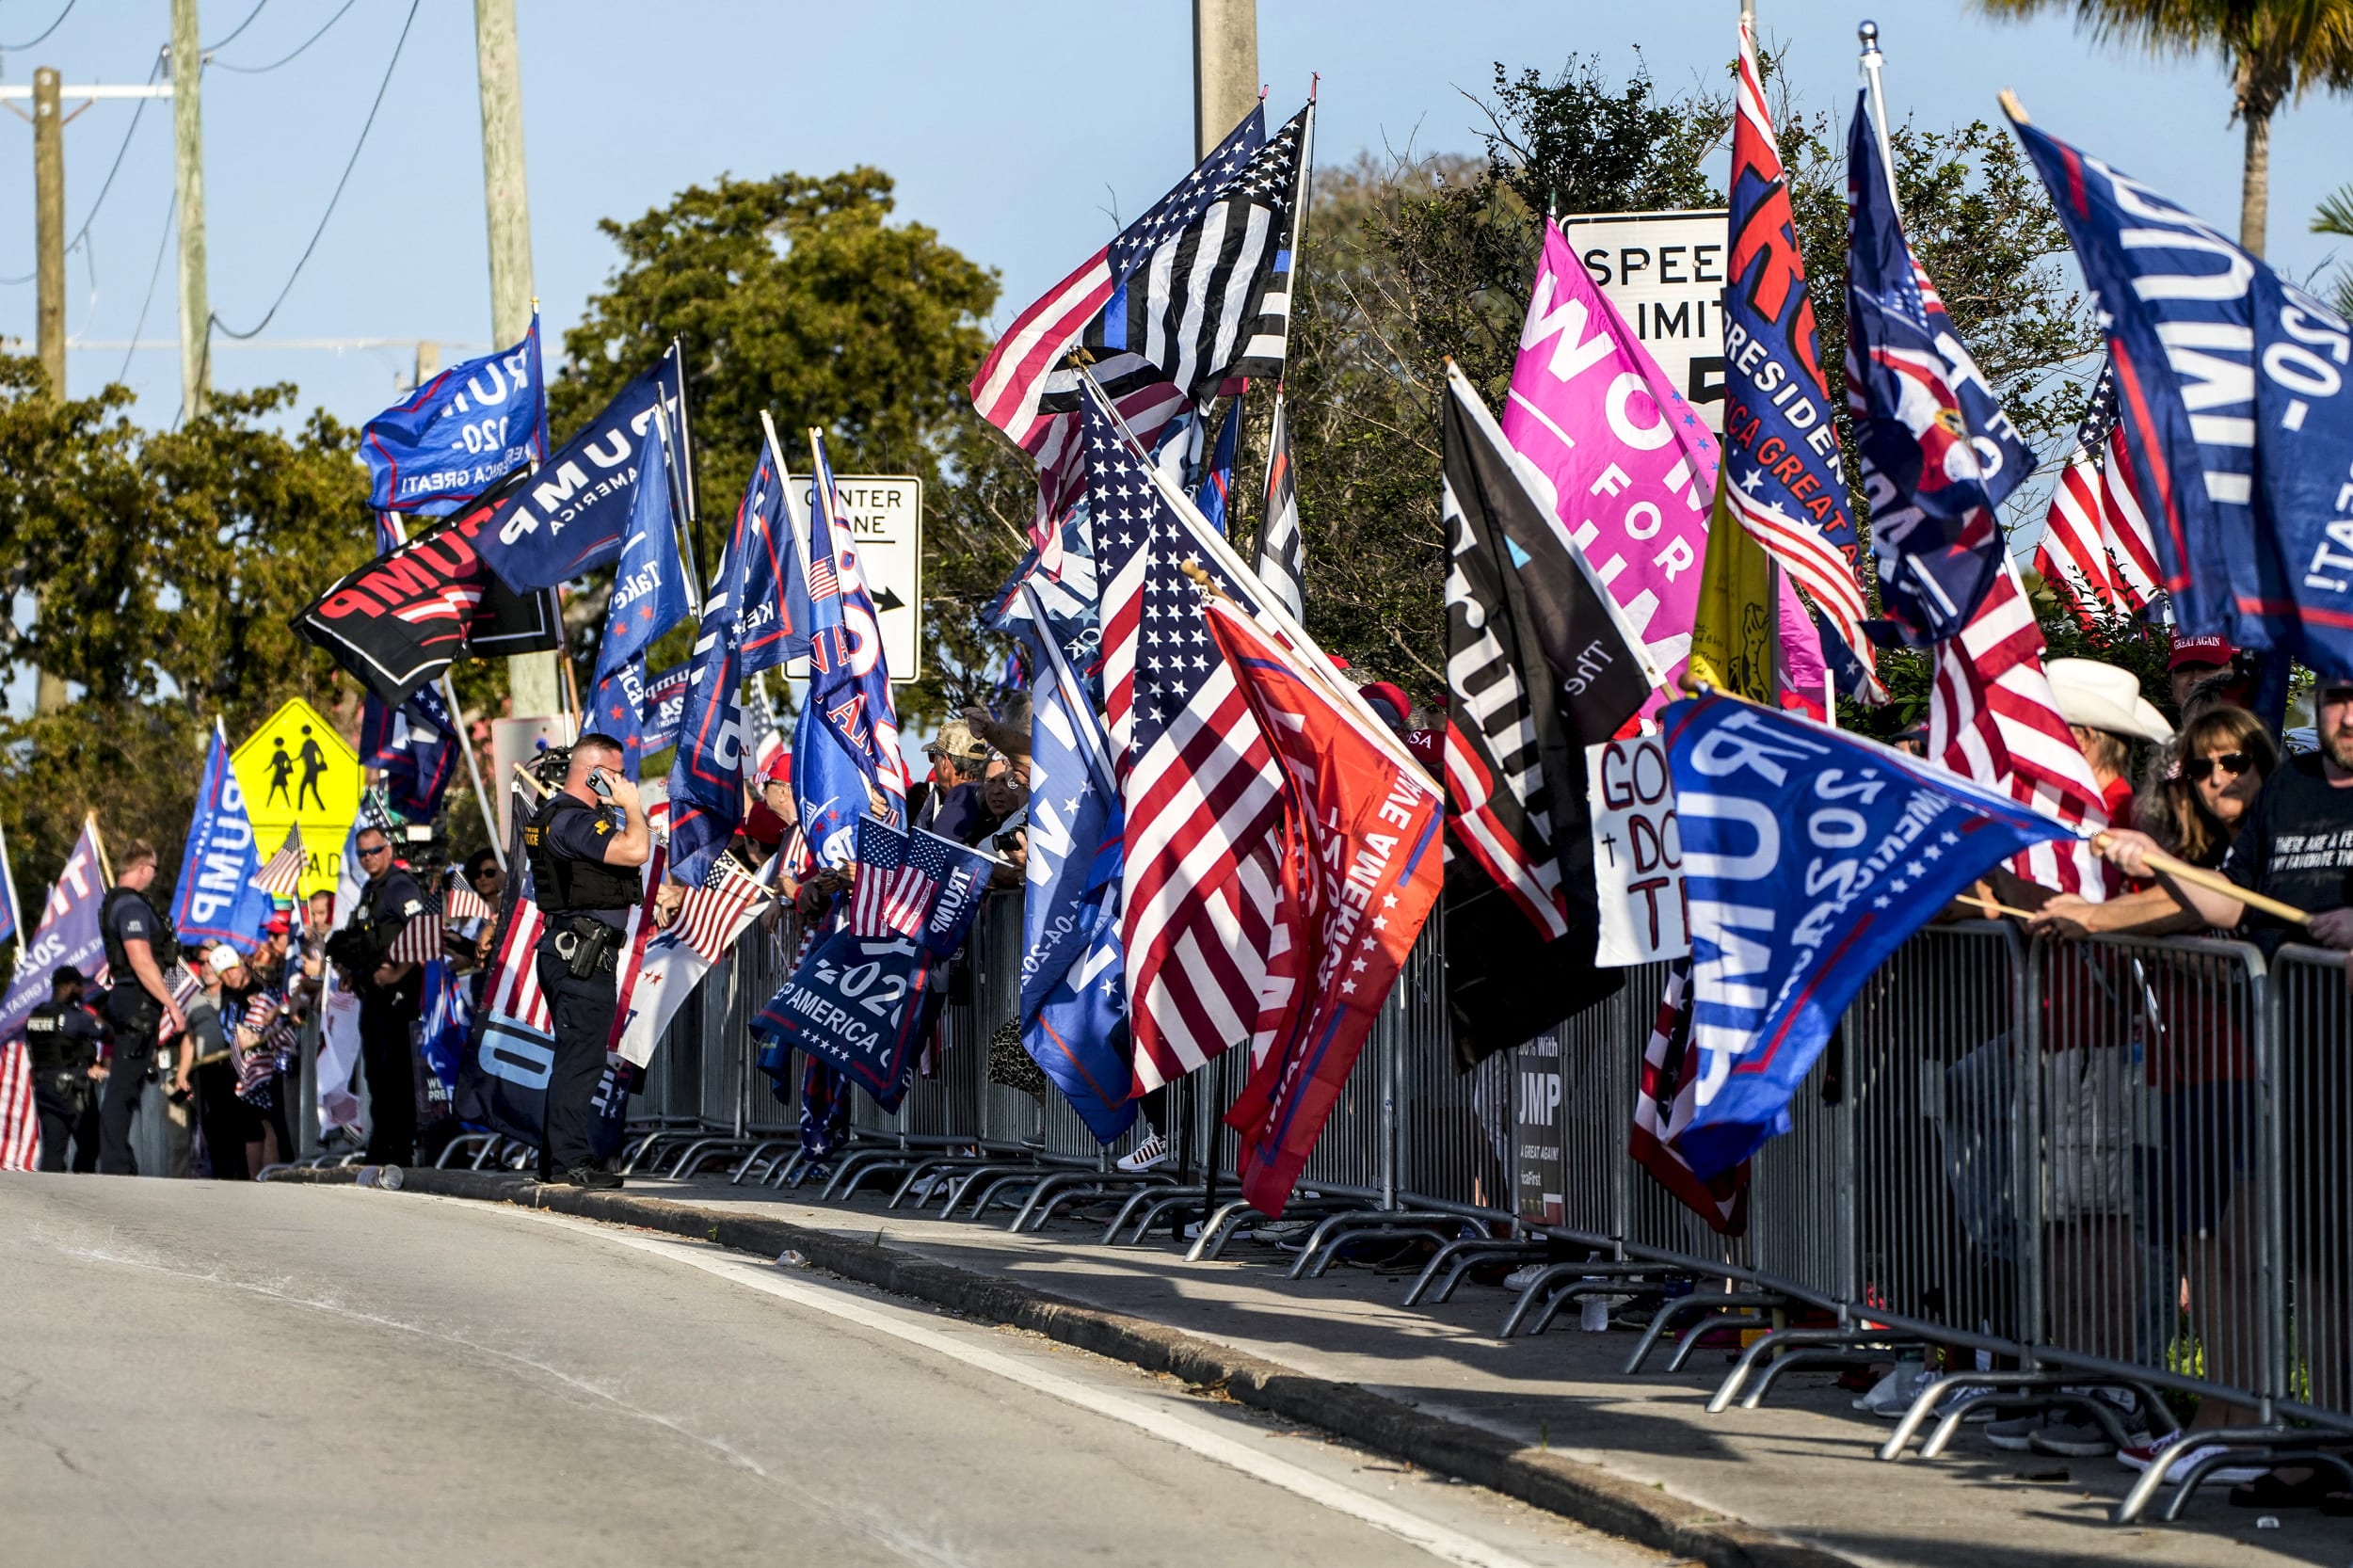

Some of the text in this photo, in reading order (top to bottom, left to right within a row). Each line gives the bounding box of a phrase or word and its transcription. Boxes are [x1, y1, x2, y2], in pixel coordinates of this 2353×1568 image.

[1584, 245, 1722, 286] SPEE
[1639, 300, 1724, 340] IMI
[1520, 269, 1713, 532] WOM
[1723, 312, 1851, 506] RESIDEN
[1757, 437, 1847, 533] GREAT
[805, 489, 901, 508] CNTER
[855, 516, 886, 534] NE
[1590, 461, 1694, 584] FOR
[2174, 636, 2220, 650] GREAT AGAIN
[1408, 730, 1432, 749] SA
[1601, 742, 1673, 811] GO
[2305, 834, 2329, 852] ARE
[2328, 832, 2338, 849] A
[2339, 830, 2353, 849] FE
[2286, 850, 2335, 870] FAVORITE
[787, 987, 878, 1053] AMERICA
[1518, 1036, 1559, 1058] 00% With
[1525, 1144, 1540, 1160] GREAT
[1541, 1146, 1559, 1161] AGAIN!
[1521, 1170, 1541, 1187] icaFirst
